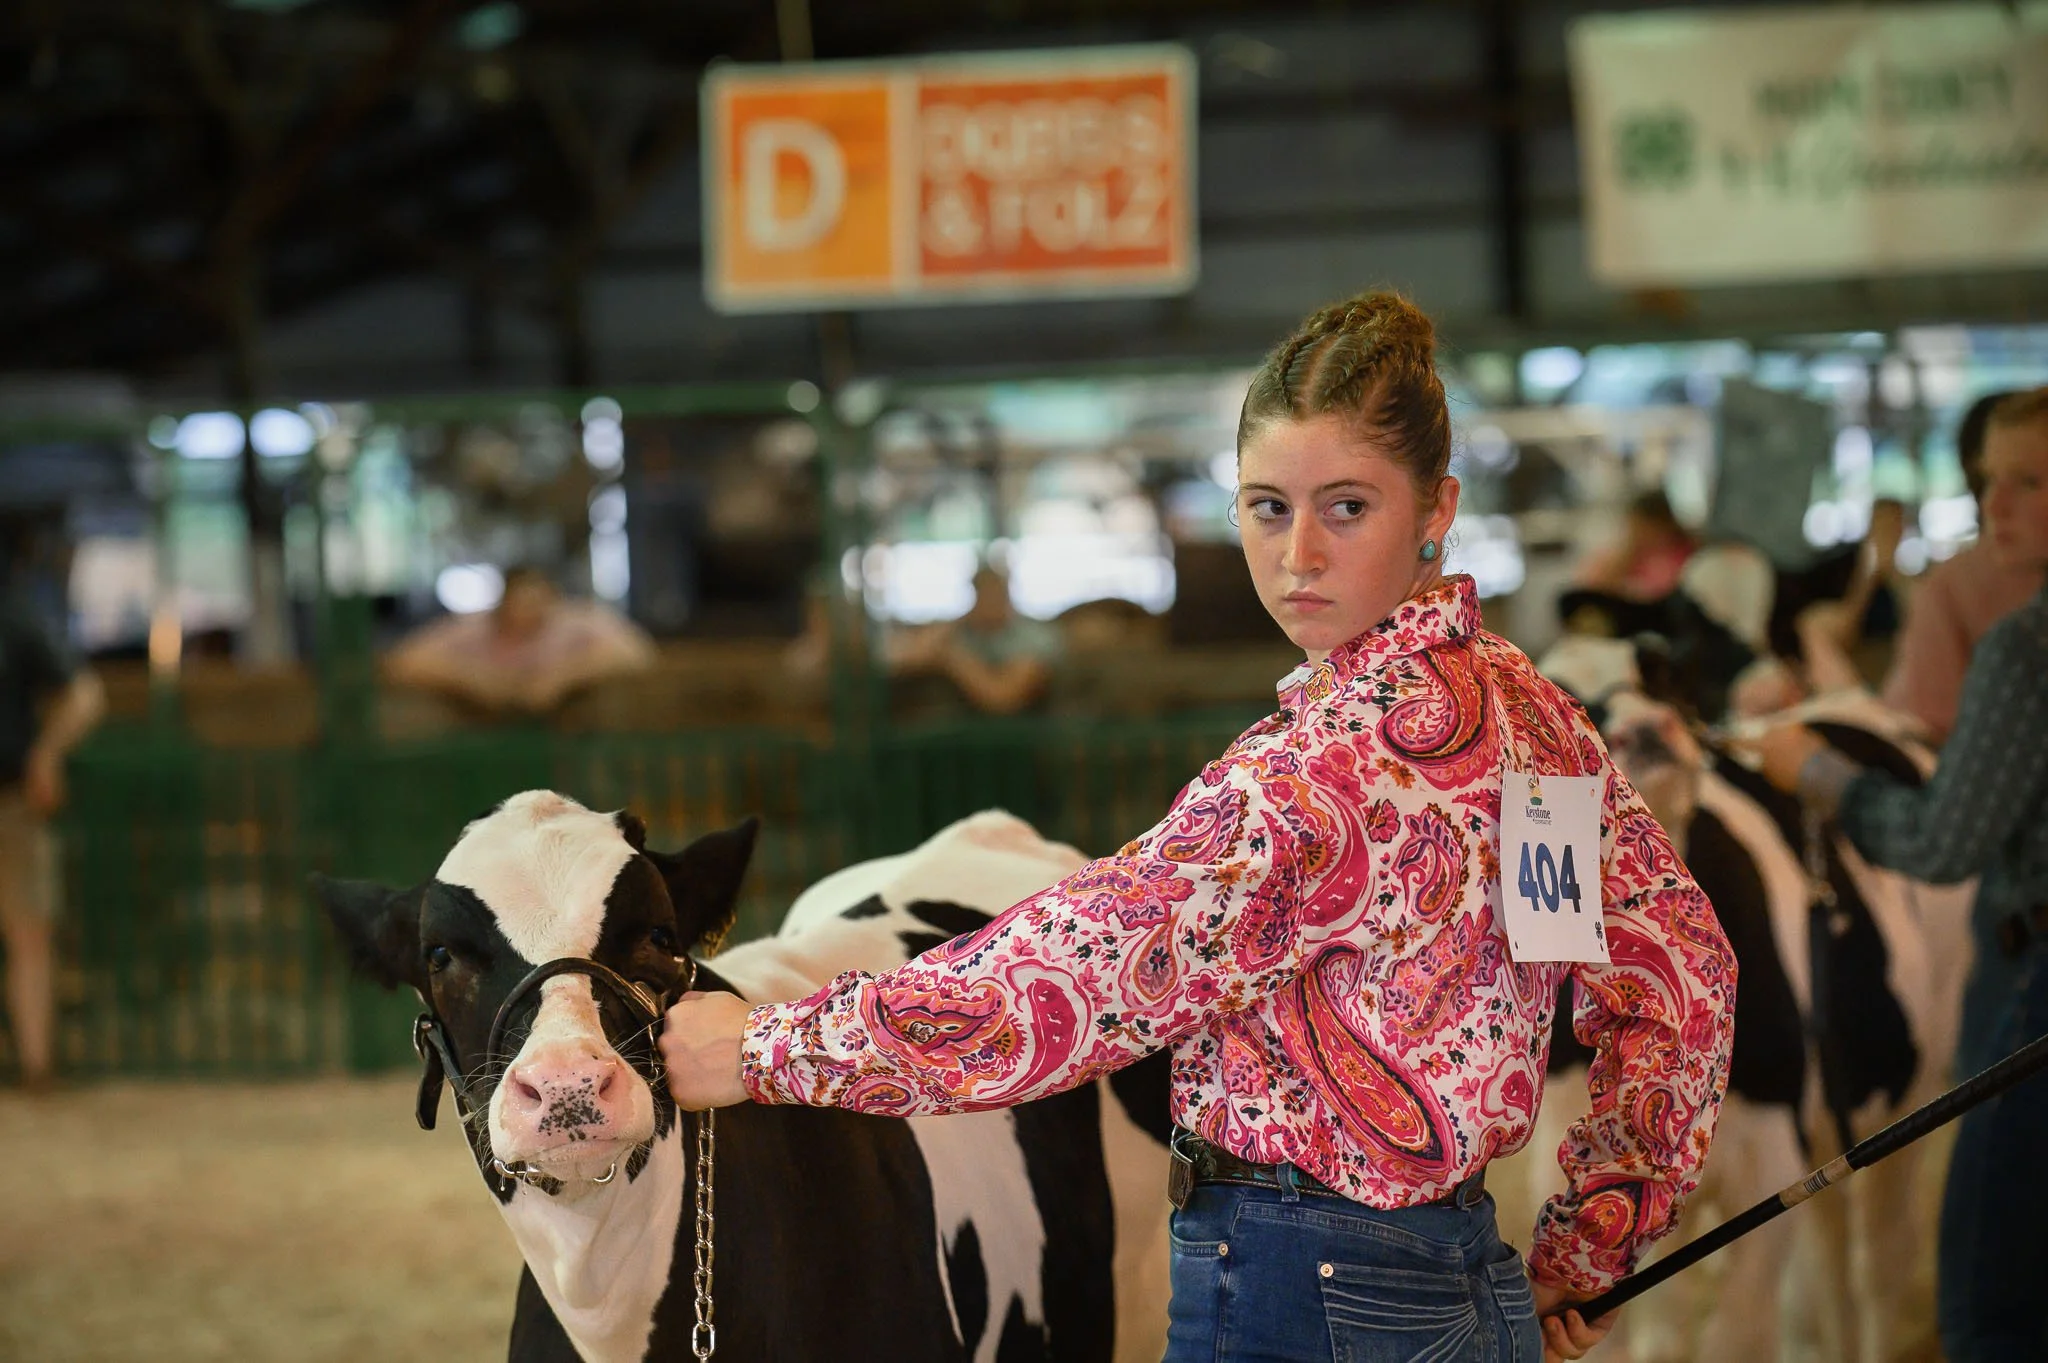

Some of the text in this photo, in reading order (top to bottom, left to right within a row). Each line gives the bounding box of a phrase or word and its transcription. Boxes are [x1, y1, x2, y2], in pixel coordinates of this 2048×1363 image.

[742, 115, 848, 253] D
[929, 174, 1167, 254] & FOLZ
[1518, 842, 1581, 913] 404
